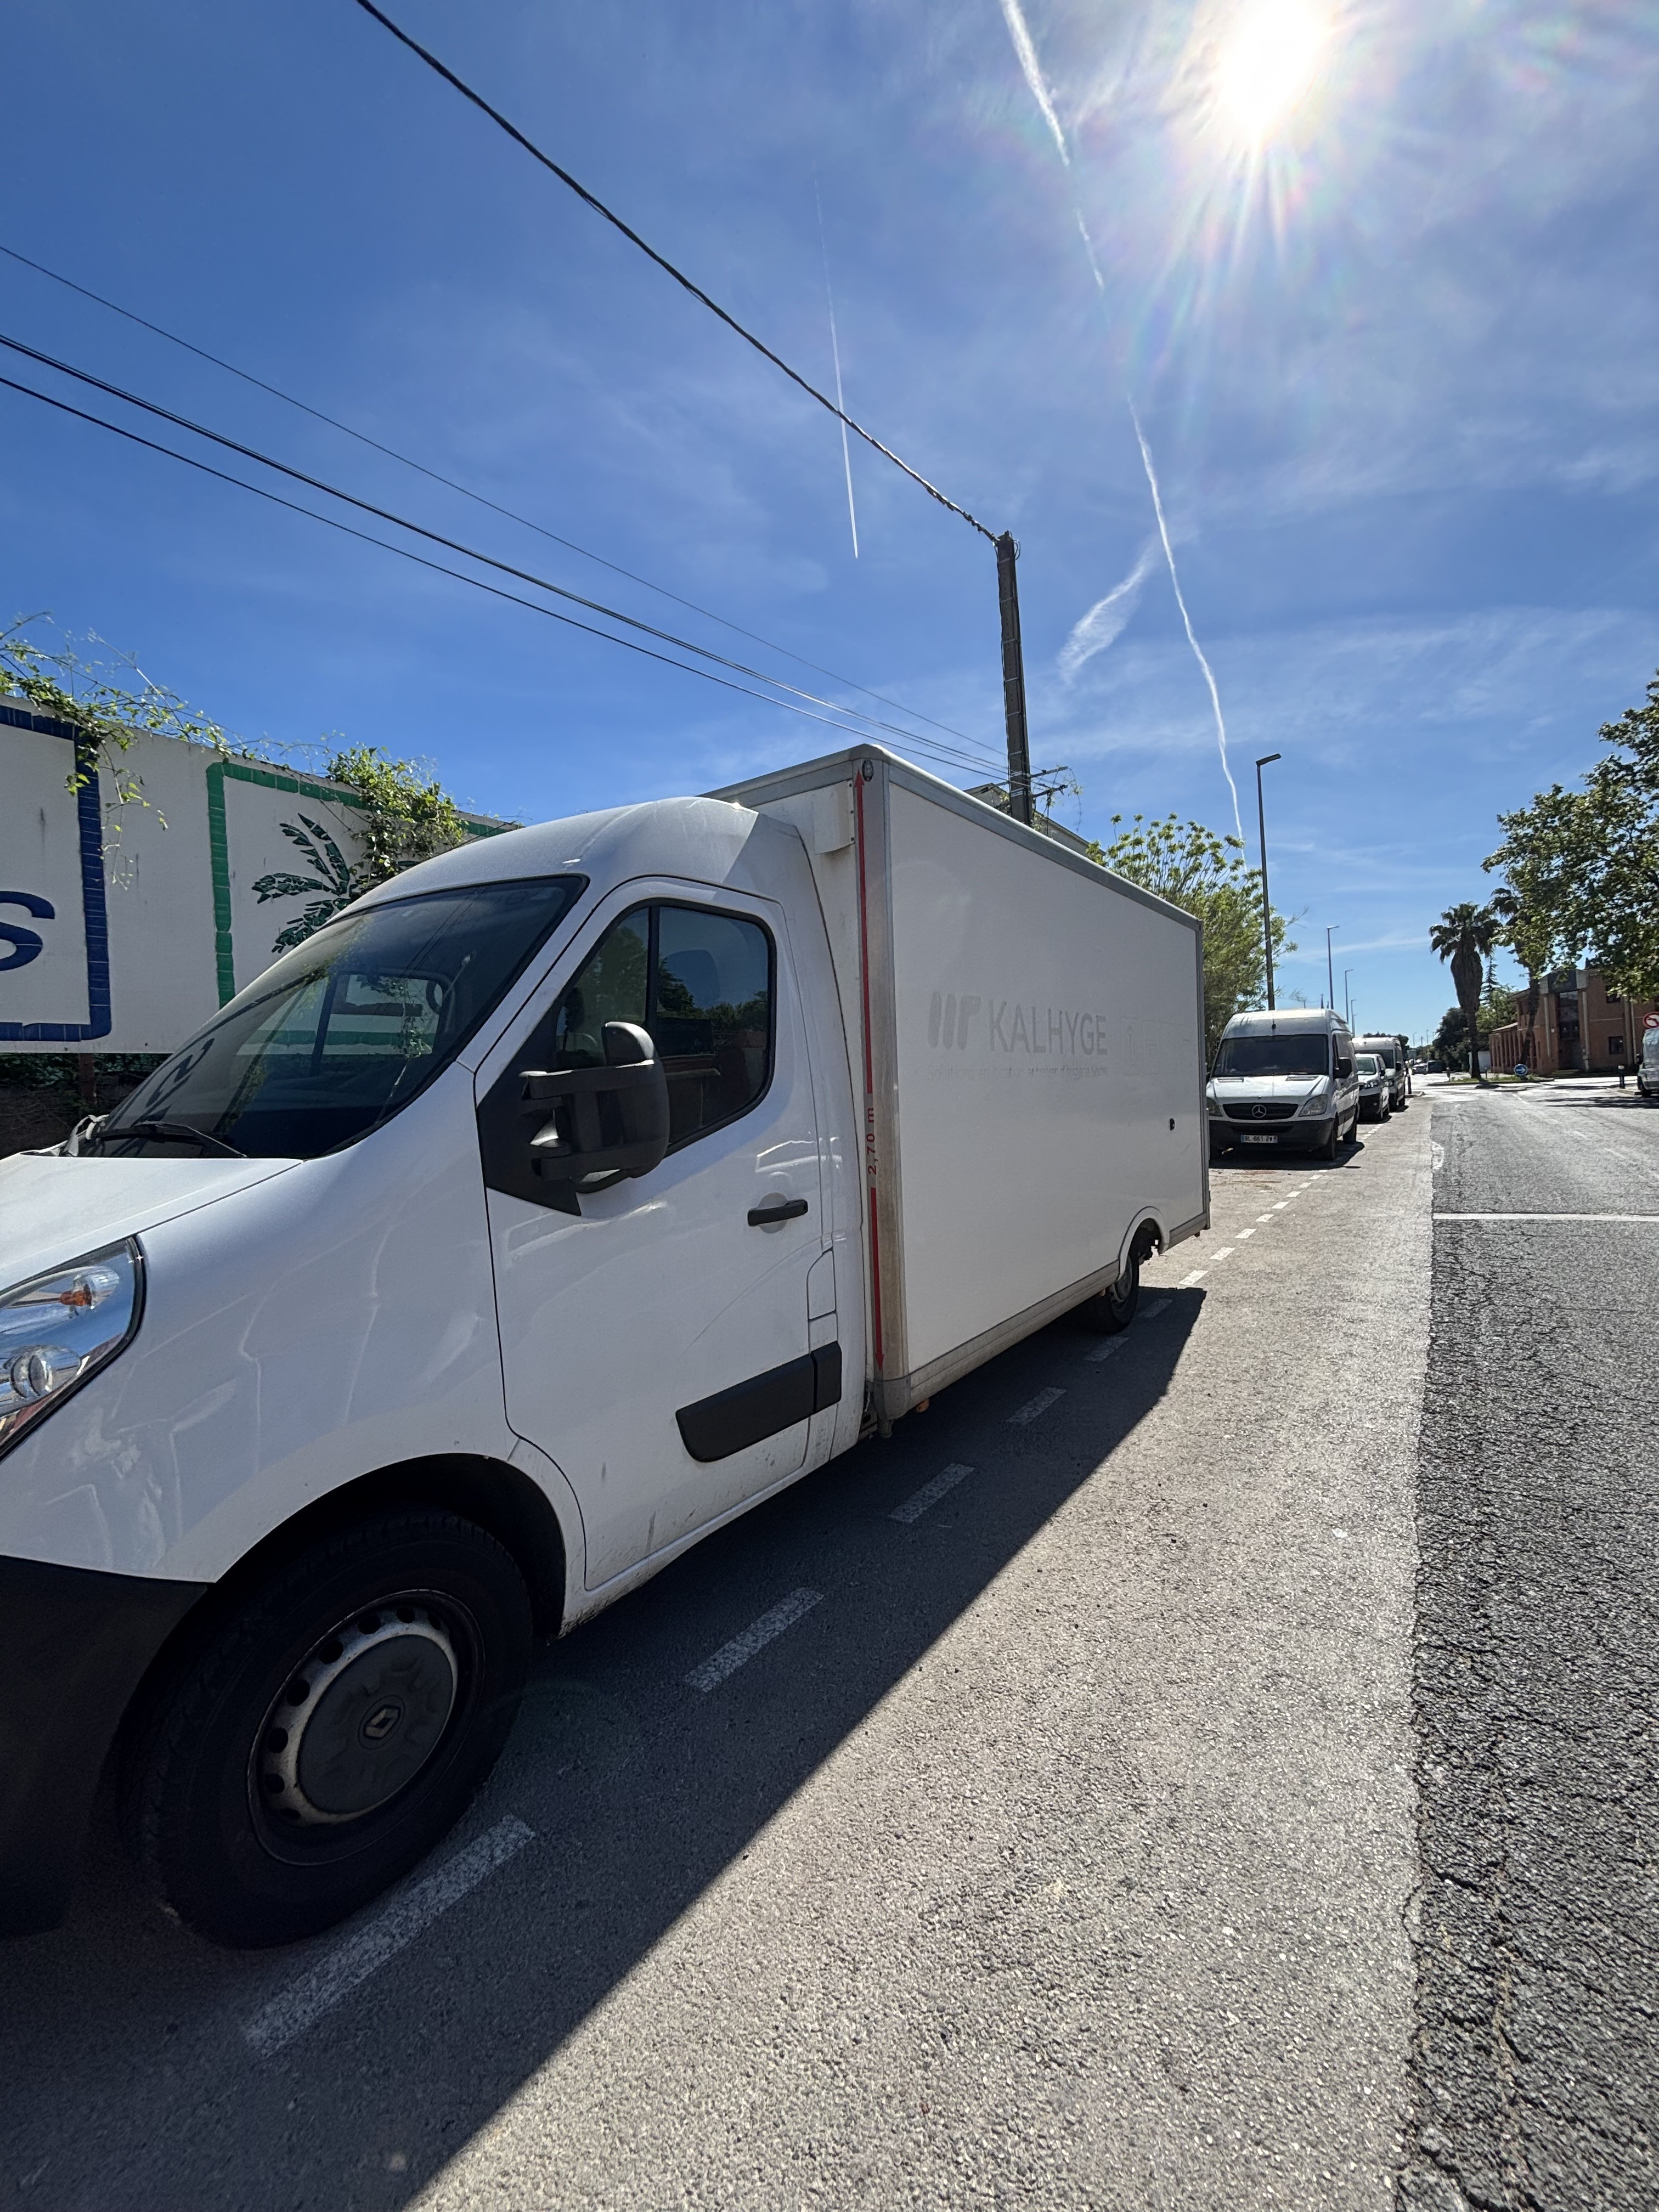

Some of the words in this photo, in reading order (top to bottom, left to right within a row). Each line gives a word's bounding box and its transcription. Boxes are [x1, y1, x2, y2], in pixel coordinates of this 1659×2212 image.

[988, 999, 1108, 1056] KALHYGE
[867, 1107, 874, 1124] m
[866, 1133, 878, 1175] 2,70
